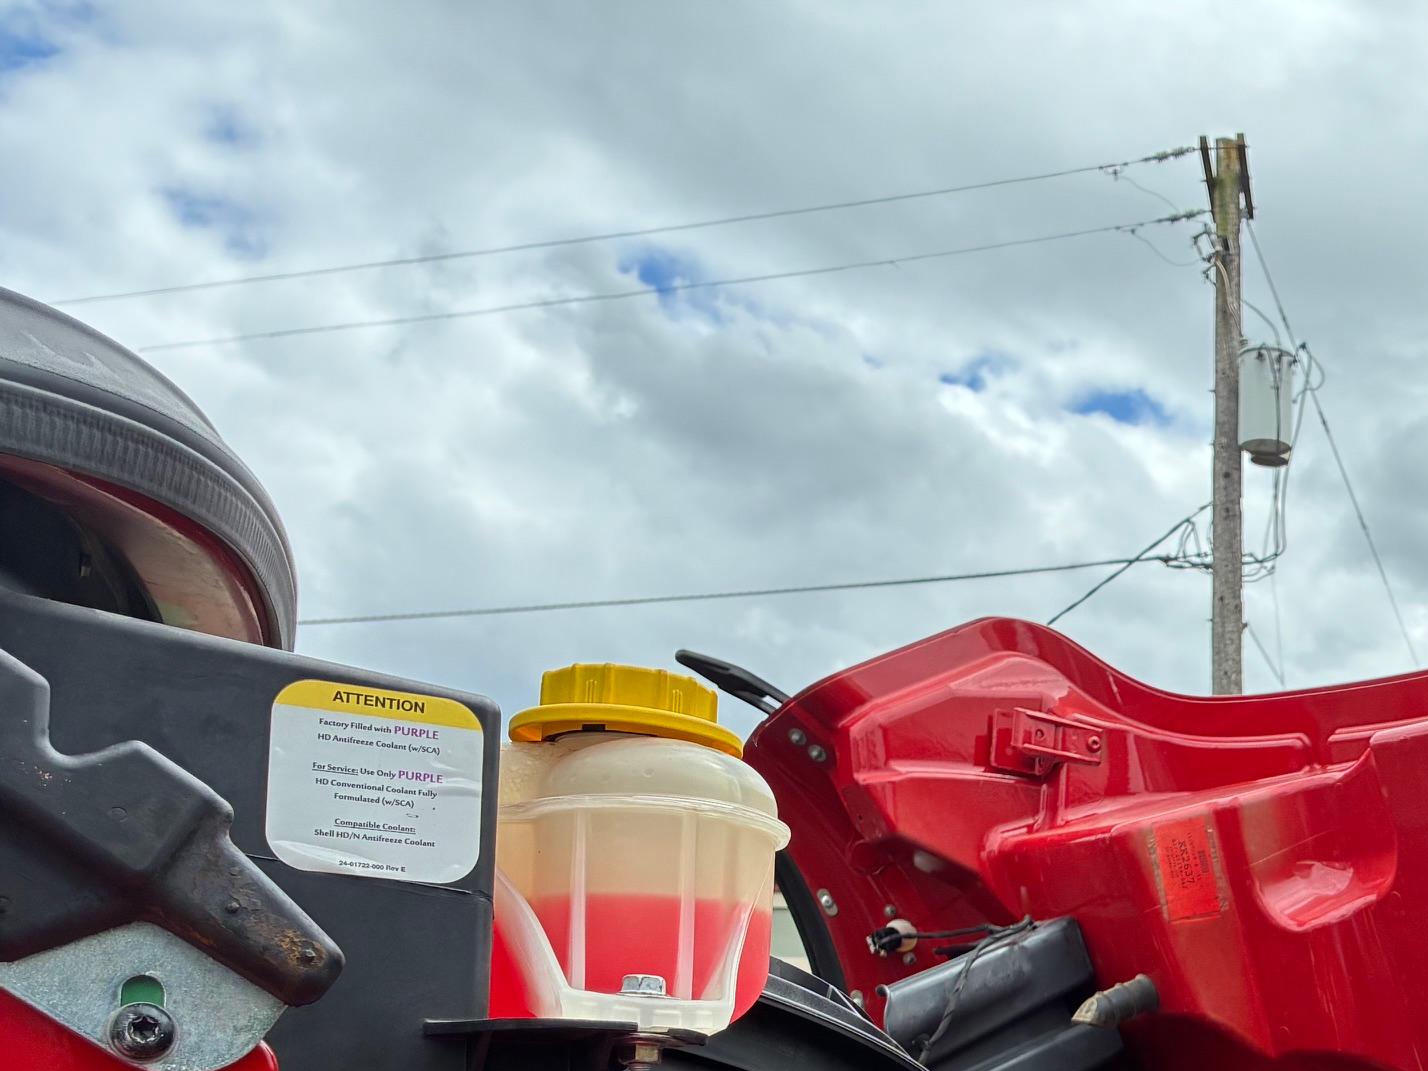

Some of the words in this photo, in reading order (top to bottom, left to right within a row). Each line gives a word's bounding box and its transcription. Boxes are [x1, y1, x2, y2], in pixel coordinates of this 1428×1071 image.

[333, 690, 425, 713] ATTENTION
[319, 718, 349, 730] Factory
[351, 722, 372, 731] Filled
[374, 725, 391, 733] with
[394, 726, 439, 739] PURPLE
[332, 735, 374, 746] Antifreeze
[376, 740, 407, 750] Coolant
[408, 744, 440, 755] (w/SCA)
[312, 762, 325, 771] For
[327, 764, 358, 774] Service:
[360, 768, 375, 776] Use
[377, 770, 396, 779] Only
[398, 770, 443, 783] PURPLE
[330, 780, 384, 792] Conventional
[386, 786, 416, 796] Coolant
[418, 789, 438, 799] Fully
[334, 793, 380, 804] Formulated
[381, 797, 414, 808] (w/SCA)
[334, 818, 380, 831] Compatible
[382, 823, 416, 833] Coolant:
[314, 830, 335, 838] Shell
[336, 831, 360, 840] HD/N
[362, 833, 402, 844] Antifreeze
[404, 838, 435, 847] Coolant
